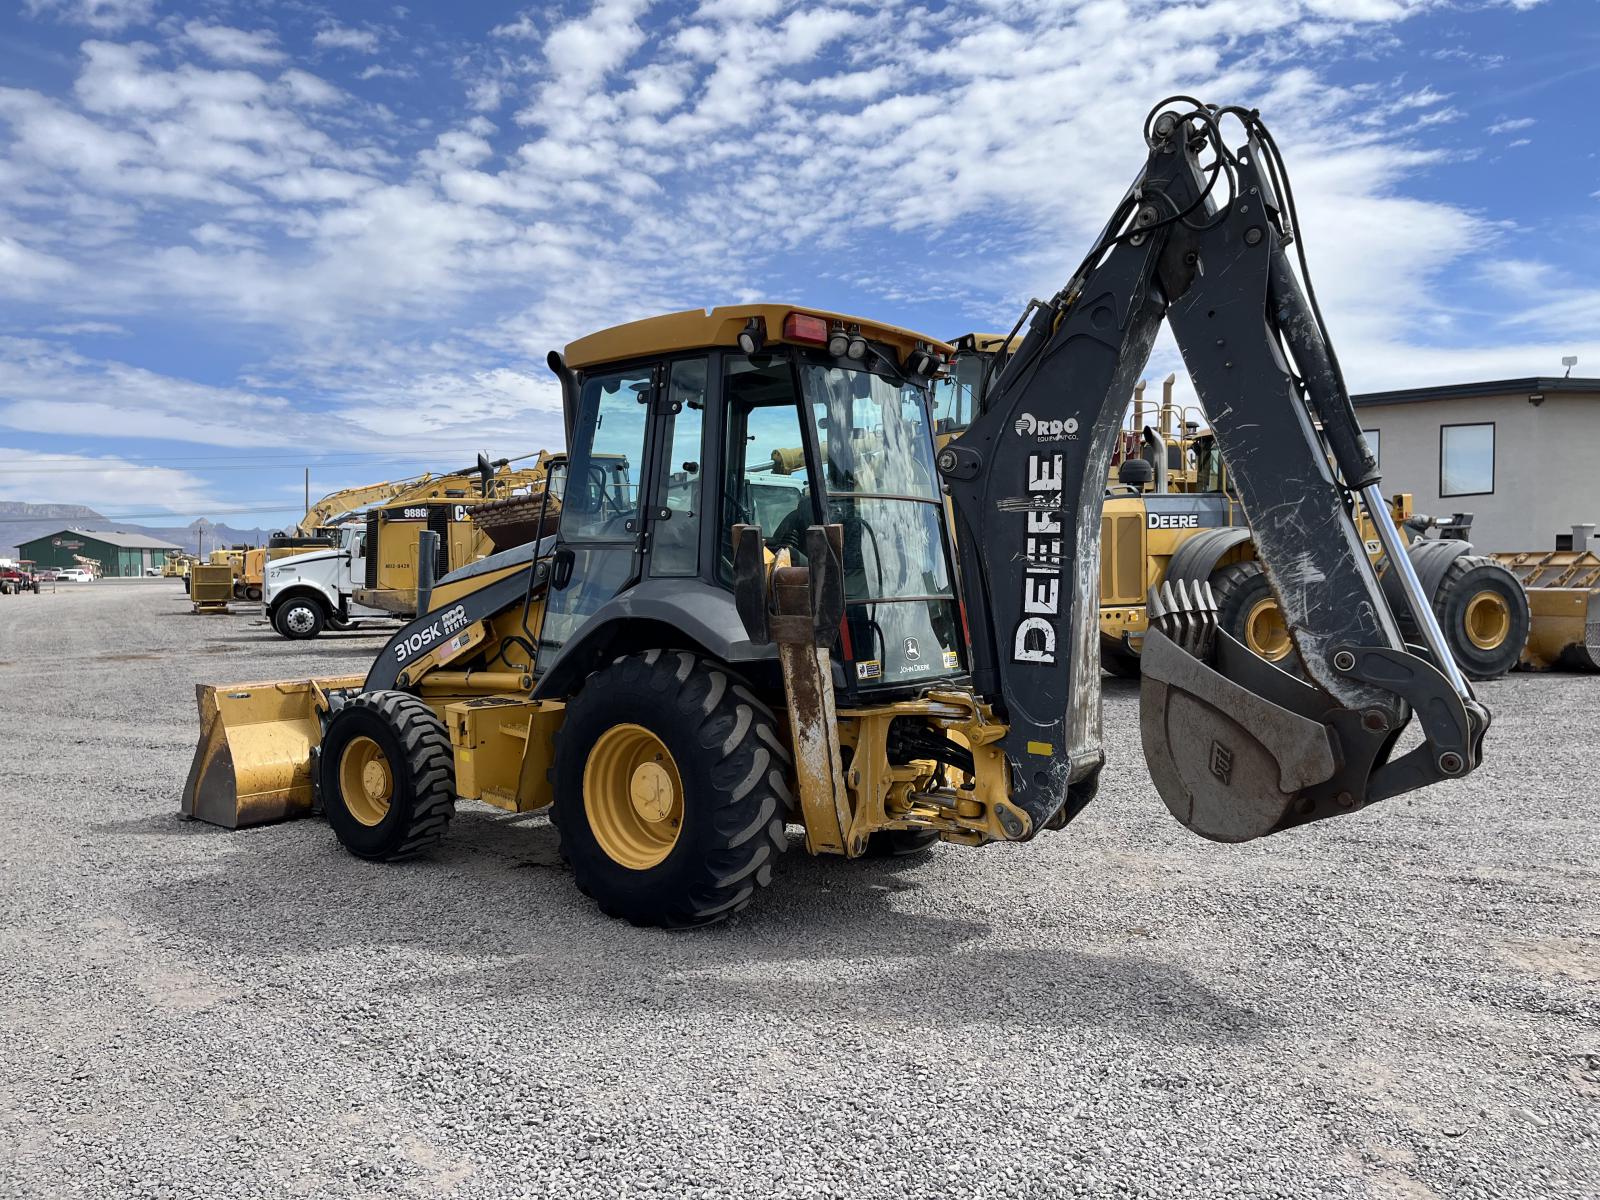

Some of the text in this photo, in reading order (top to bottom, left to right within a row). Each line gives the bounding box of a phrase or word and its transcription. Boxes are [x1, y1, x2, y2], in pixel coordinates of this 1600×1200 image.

[1037, 418, 1079, 436] RDO
[1148, 513, 1198, 529] DEERE
[1014, 454, 1064, 664] DEERE
[444, 616, 468, 636] RENTS
[394, 621, 442, 662] 310SK
[900, 665, 914, 673] JOHN
